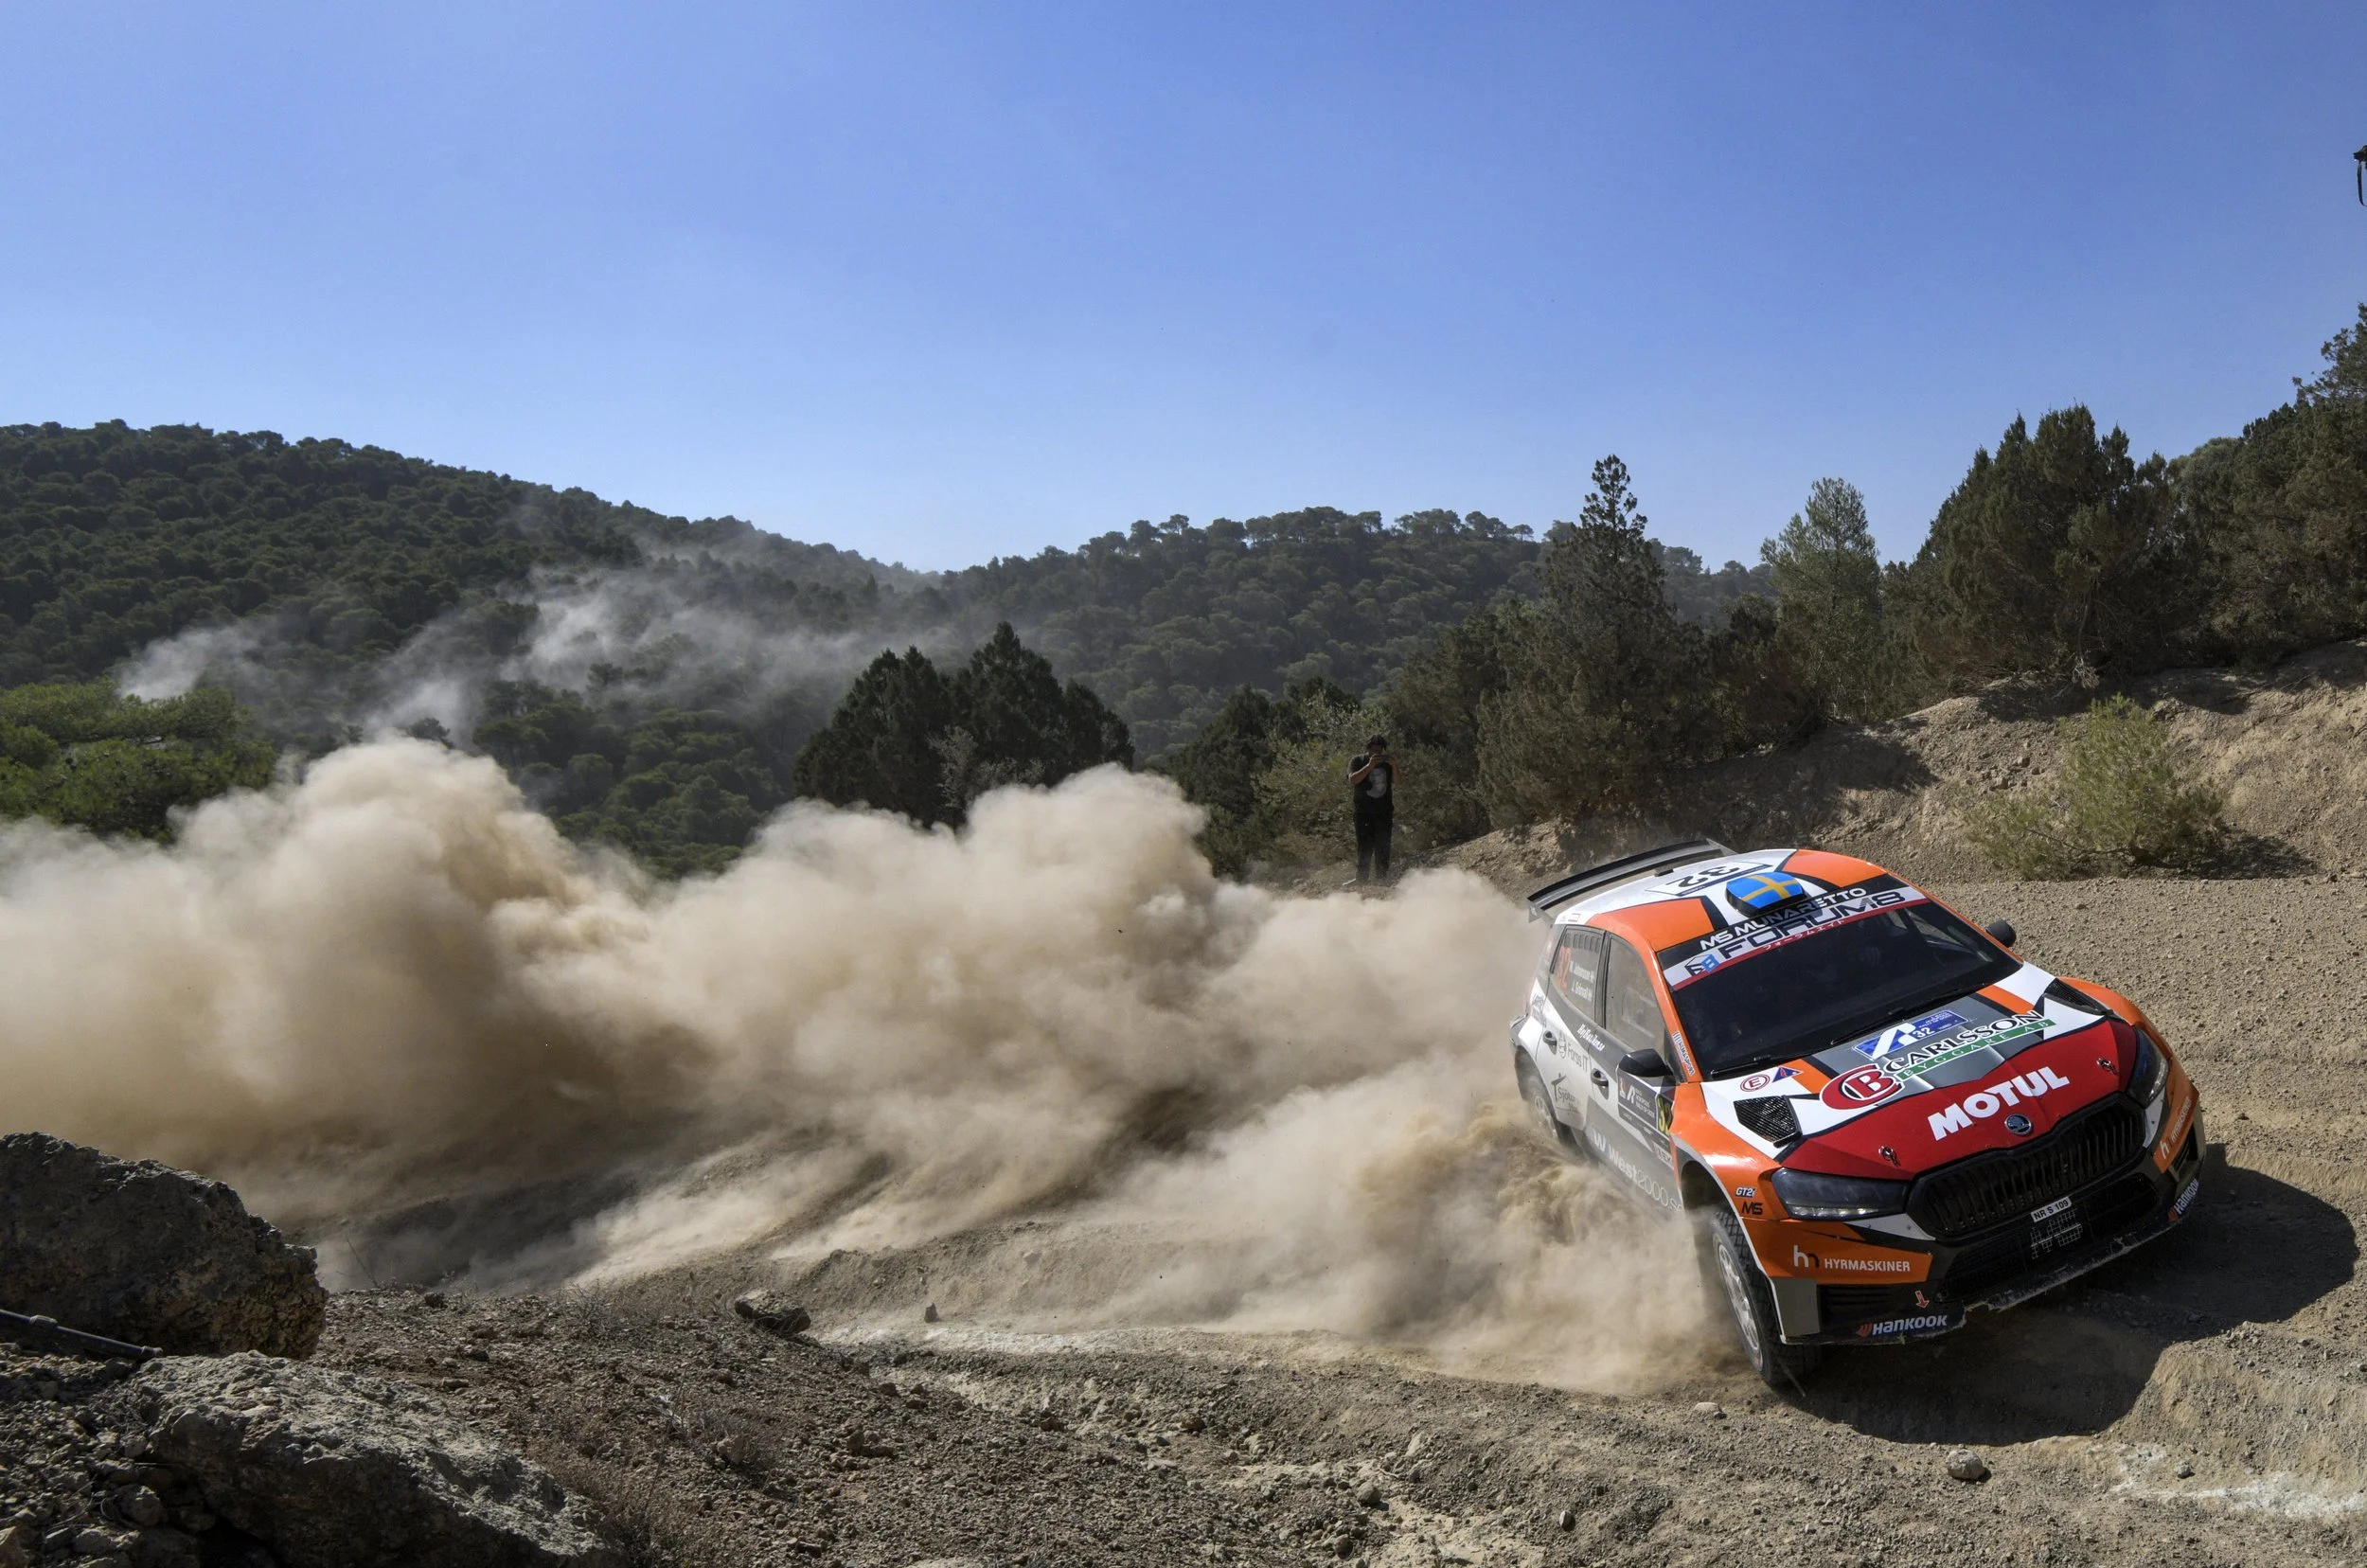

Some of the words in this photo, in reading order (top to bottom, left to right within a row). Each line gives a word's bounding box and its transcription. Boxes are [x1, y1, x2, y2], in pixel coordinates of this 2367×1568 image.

[1700, 930, 1734, 951] MS
[1735, 888, 1867, 935] MUNARETTO
[1718, 892, 1905, 959] FORUM8
[1885, 1010, 2043, 1072] CARLSSON
[1903, 1034, 2008, 1077] BYGGARE
[2024, 1021, 2049, 1032] AB
[1913, 1027, 1935, 1038] 32
[1928, 1066, 2070, 1141] MOTUL
[1741, 1202, 1763, 1215] MS
[2033, 1209, 2047, 1221] NR
[2047, 1205, 2054, 1215] S
[2055, 1199, 2069, 1211] 109
[1824, 1257, 1911, 1272] HYRMASKINER
